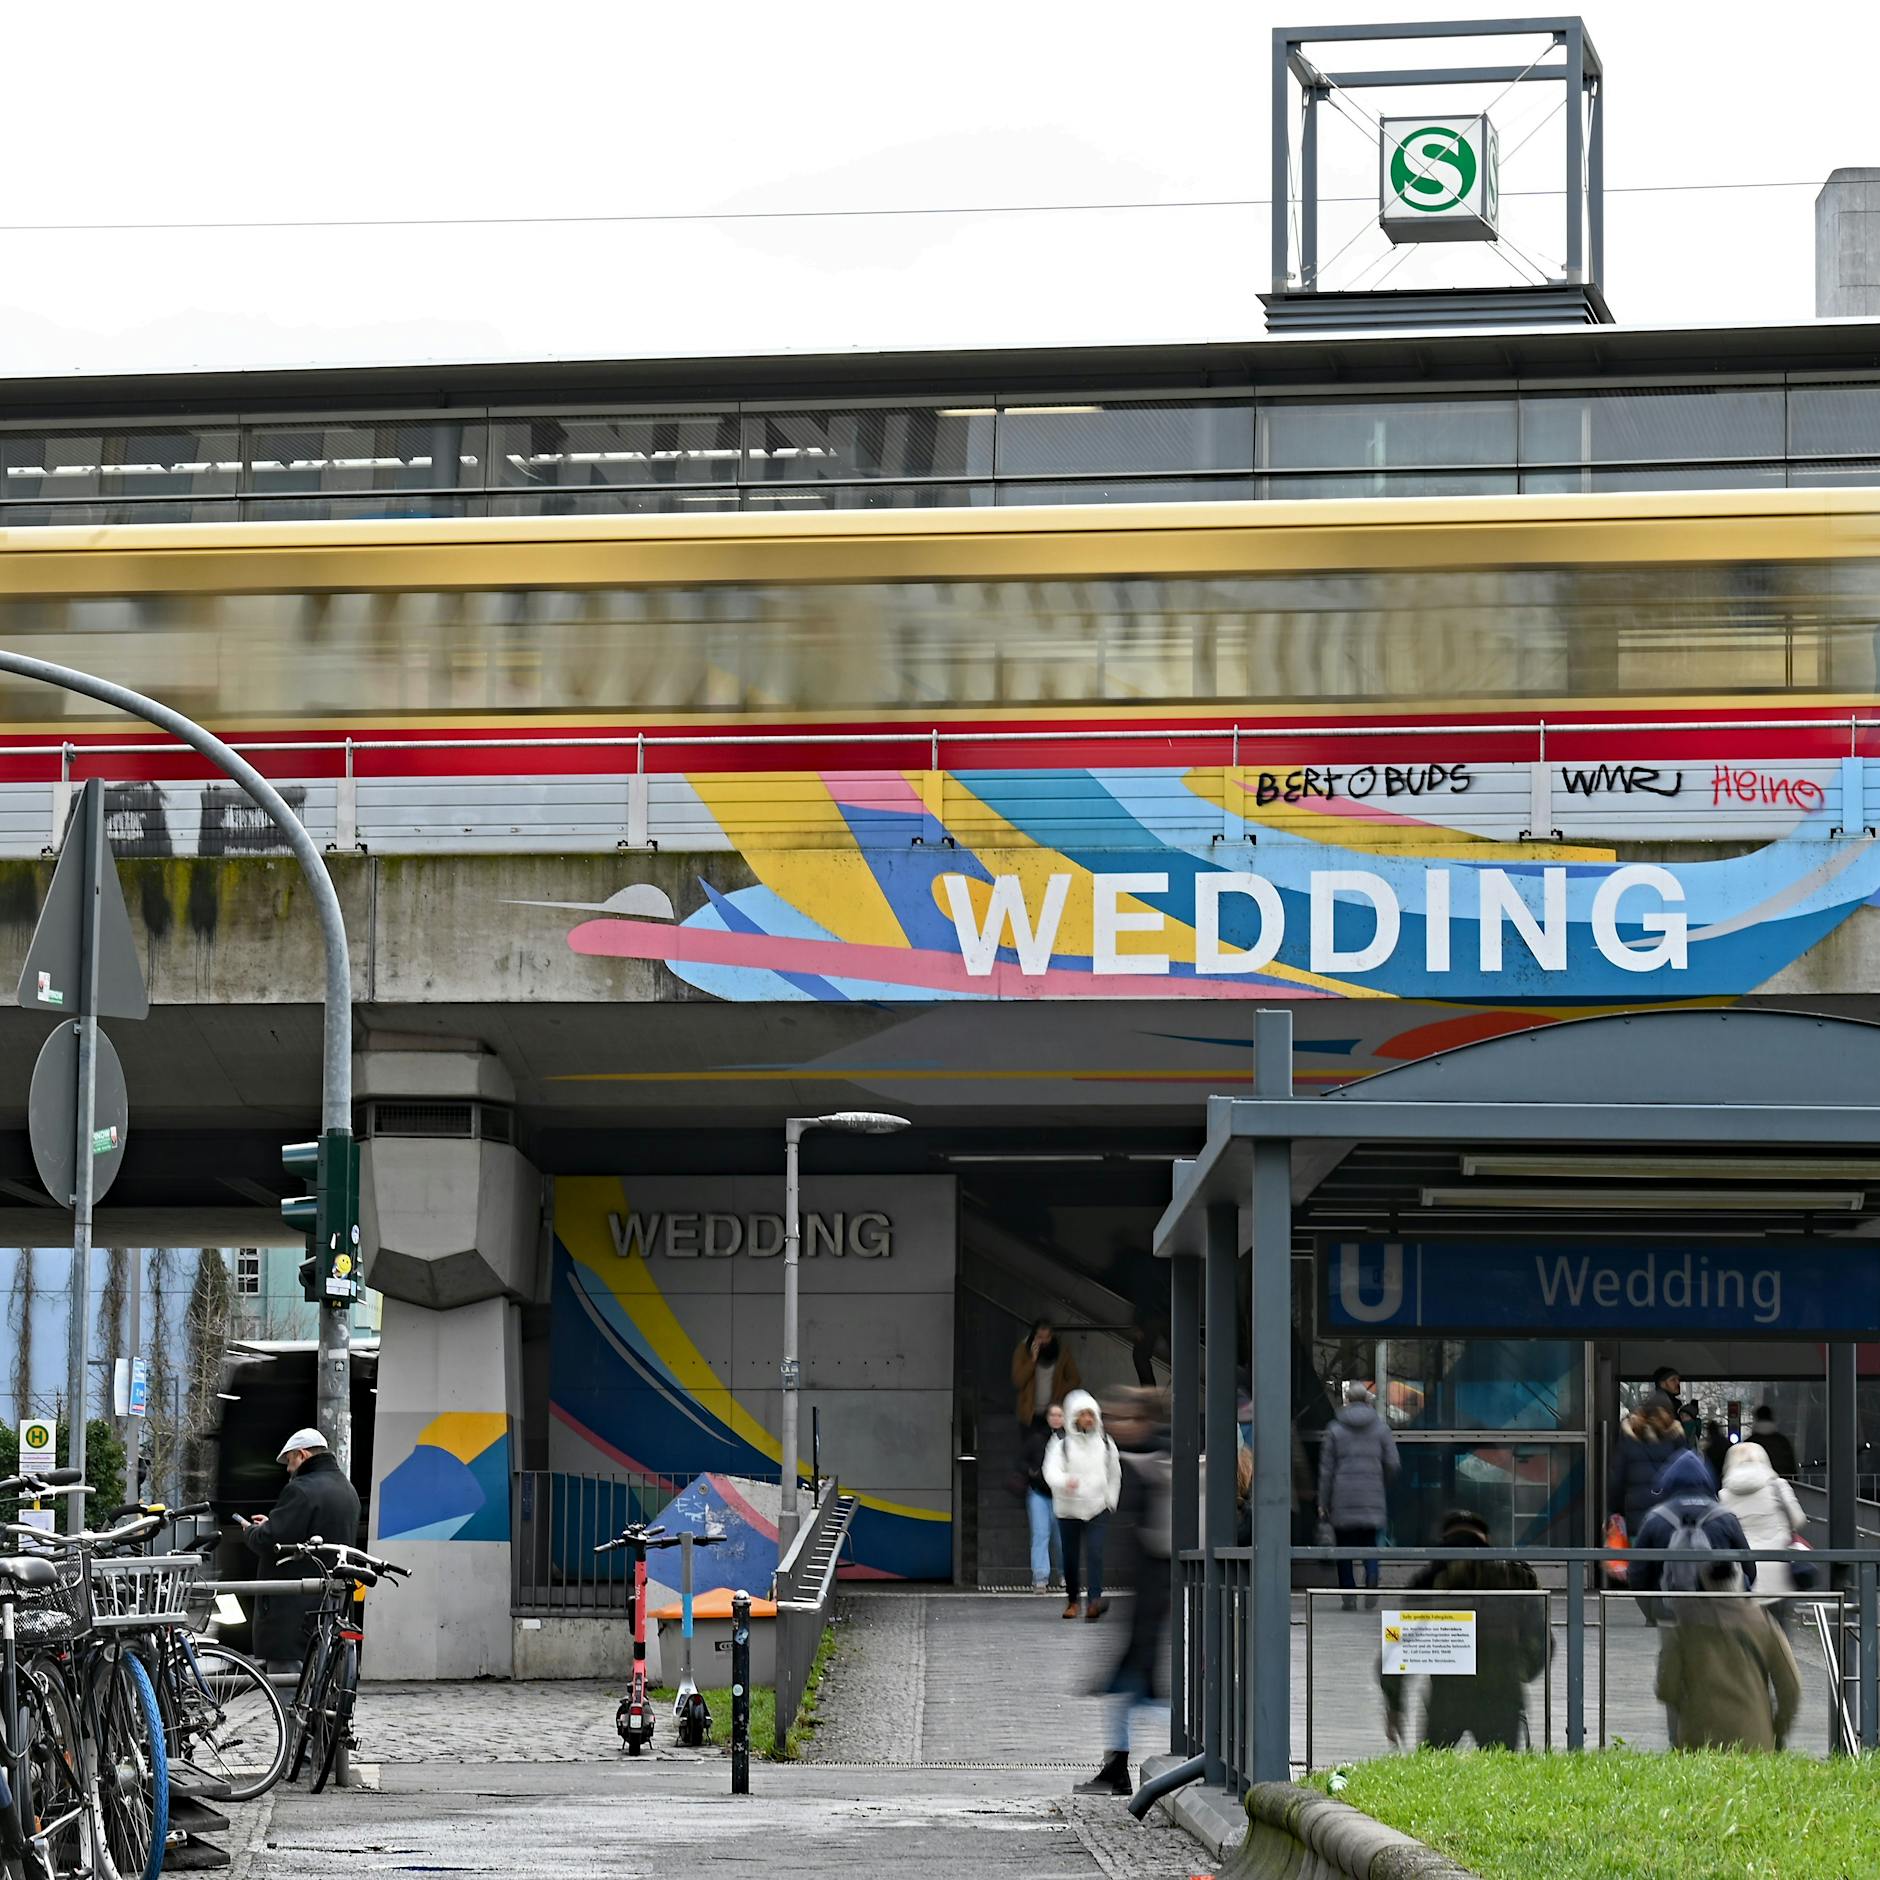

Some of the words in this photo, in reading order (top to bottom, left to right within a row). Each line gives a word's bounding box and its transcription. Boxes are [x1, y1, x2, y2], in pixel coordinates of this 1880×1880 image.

[1403, 133, 1463, 206] S
[941, 863, 1691, 977] WEDDING
[608, 1211, 894, 1259] WEDDNG
[1340, 1243, 1404, 1323] U
[1535, 1252, 1782, 1325] Wedding
